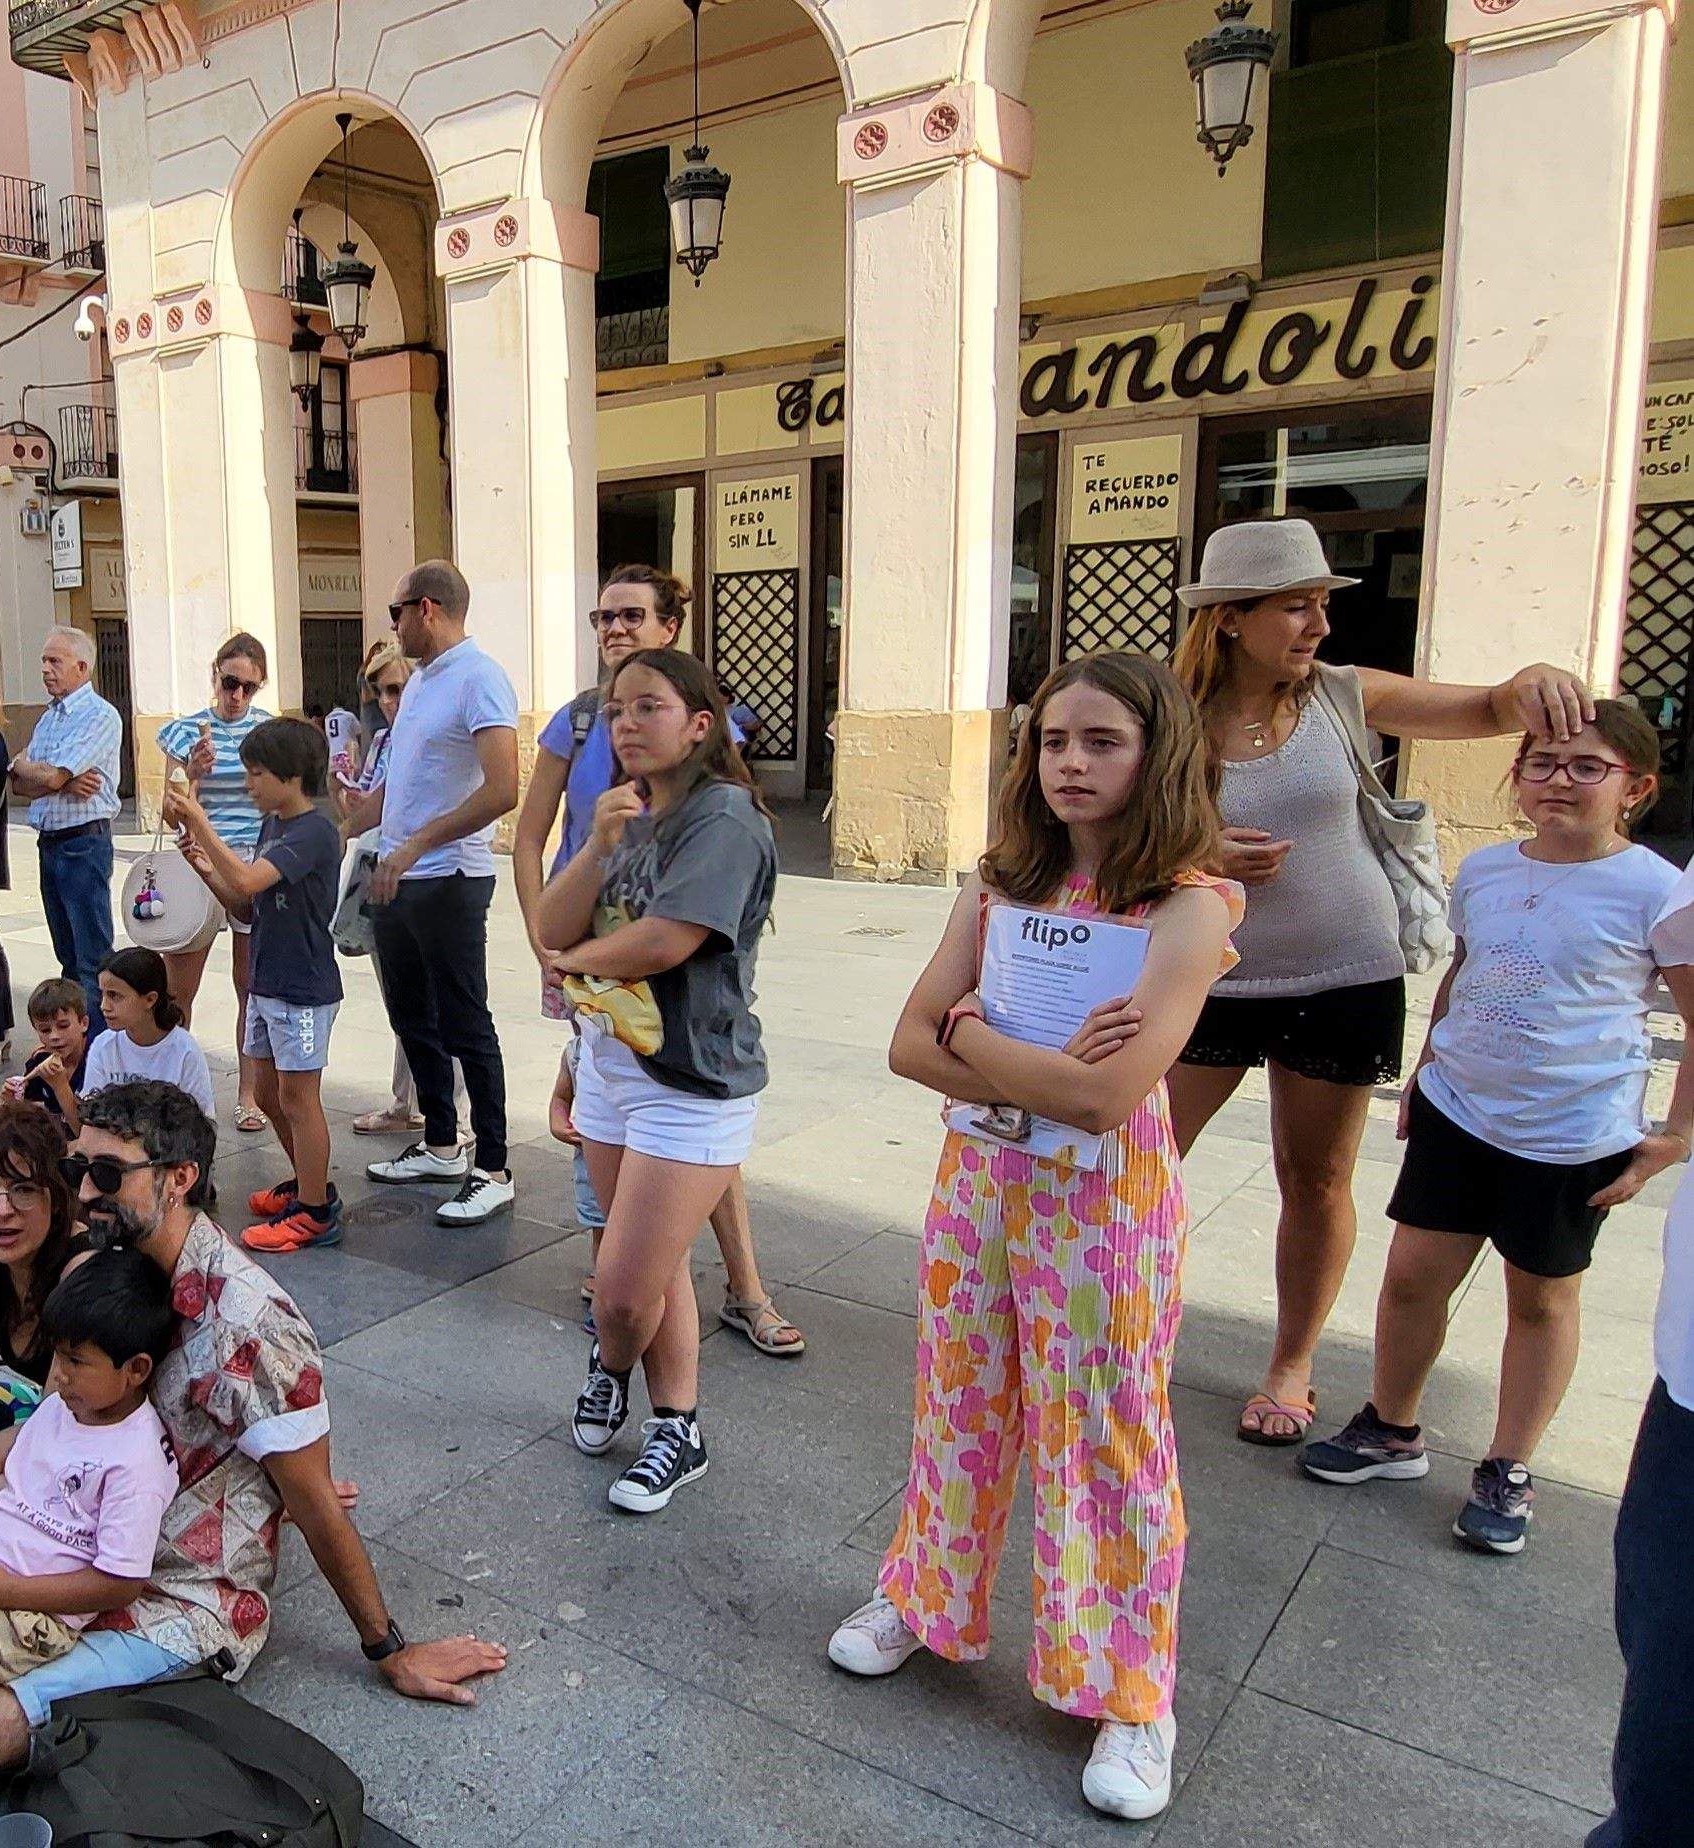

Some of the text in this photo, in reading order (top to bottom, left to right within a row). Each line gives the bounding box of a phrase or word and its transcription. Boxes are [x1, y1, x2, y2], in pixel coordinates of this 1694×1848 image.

[776, 275, 1436, 432] Ca andoli
[1664, 392, 1694, 407] CAF
[1659, 414, 1694, 430] SOL
[1082, 454, 1106, 471] TE
[1085, 472, 1179, 494] RECUERDO
[724, 485, 793, 507] LLÁMAME
[730, 511, 765, 527] PERO
[728, 528, 777, 549] SIN LL
[329, 718, 339, 738] 9
[1020, 915, 1092, 952] flipo
[299, 1005, 315, 1054] adida
[36, 1518, 63, 1541] GOOD
